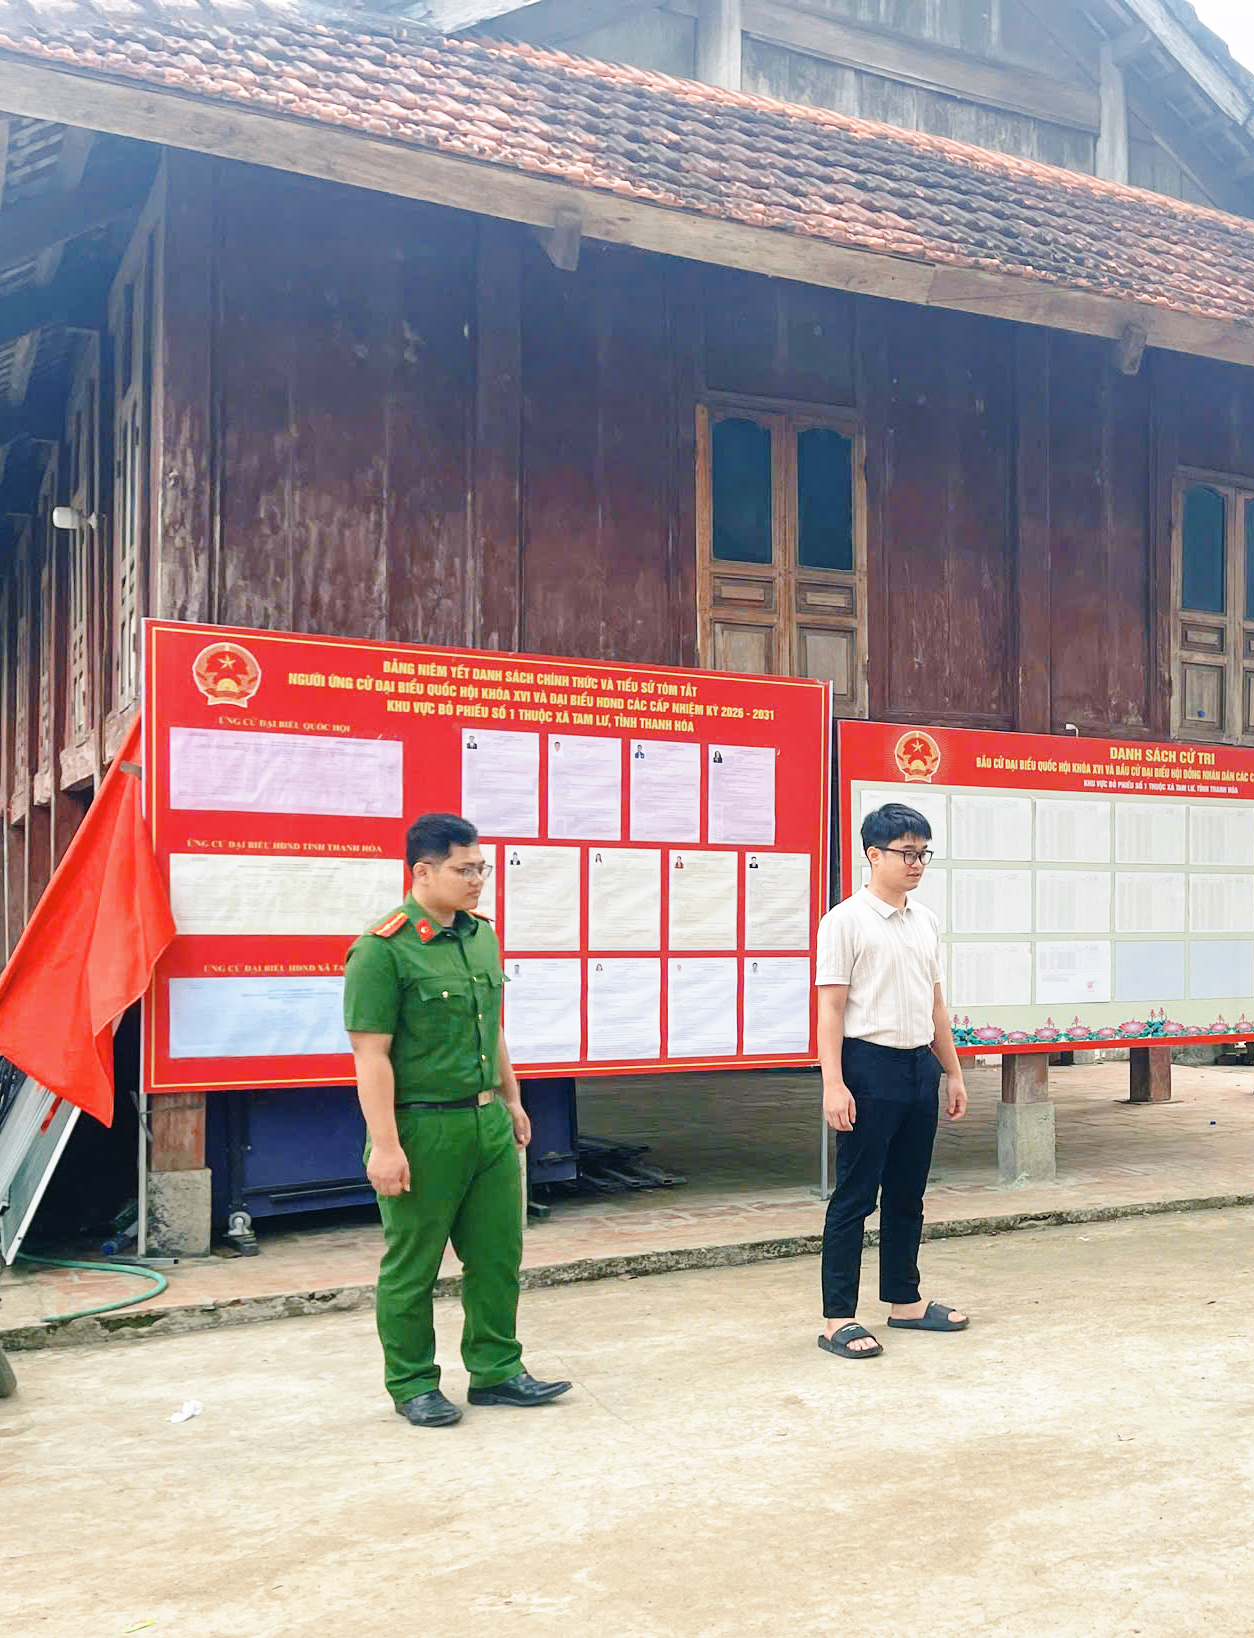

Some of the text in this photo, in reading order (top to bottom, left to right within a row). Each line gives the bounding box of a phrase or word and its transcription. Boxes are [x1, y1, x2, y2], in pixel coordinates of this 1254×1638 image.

[383, 658, 697, 698] BẢNG NIÊM YẾT DANH SÁCH CHÍNH THỨC VÀ TIỂU SỬ TÓM TẮT
[288, 672, 326, 687] NGƯỜI
[328, 675, 353, 689] ỨNG
[356, 675, 373, 690] CỬ
[375, 680, 395, 695] ĐẠI
[398, 677, 424, 694] BIỂU
[427, 680, 457, 697] QUỐC
[460, 683, 479, 701] HỘI
[481, 685, 510, 701] KHÓA
[513, 690, 531, 703] XVI
[533, 690, 547, 703] VÀ
[549, 692, 568, 707] ĐẠI
[570, 691, 594, 707] BIỂU
[596, 697, 624, 710] HĐND
[627, 695, 647, 711] CÁC
[649, 696, 670, 713] CẤP
[672, 702, 704, 717] NHIỆM
[720, 707, 744, 719] 2026
[752, 708, 775, 721] 2031
[387, 699, 410, 713] KHU
[413, 701, 435, 716] VỰC
[438, 700, 453, 715] BỎ
[456, 700, 489, 718] PHIẾU
[491, 702, 506, 719] SỐ
[509, 708, 515, 720] 1
[519, 708, 553, 724] THUỘC
[555, 710, 570, 724] XÃ
[572, 713, 593, 725] TAM
[614, 713, 637, 728] TỈNH
[639, 717, 672, 730] THANH
[674, 716, 694, 732] HÓA
[976, 755, 991, 769] BẦU
[993, 755, 1004, 769] CỬ
[1005, 759, 1018, 772] ĐẠI
[1019, 758, 1036, 771] BIỂU
[1038, 758, 1057, 772] QUỐC
[1058, 760, 1071, 775] HỘI
[1072, 761, 1091, 774] KHÓA
[1092, 764, 1104, 775] XVI
[1105, 763, 1115, 775] VÀ
[1116, 763, 1129, 776] BẦU
[1131, 764, 1142, 777] CỬ
[1142, 767, 1153, 780] ĐẠI
[1154, 766, 1170, 778] BIỂU
[1171, 767, 1182, 781] HỘI
[1236, 769, 1249, 782] CÁC
[1110, 747, 1215, 765] DANH SÁCH CỬ TRI
[333, 964, 345, 972] TA
